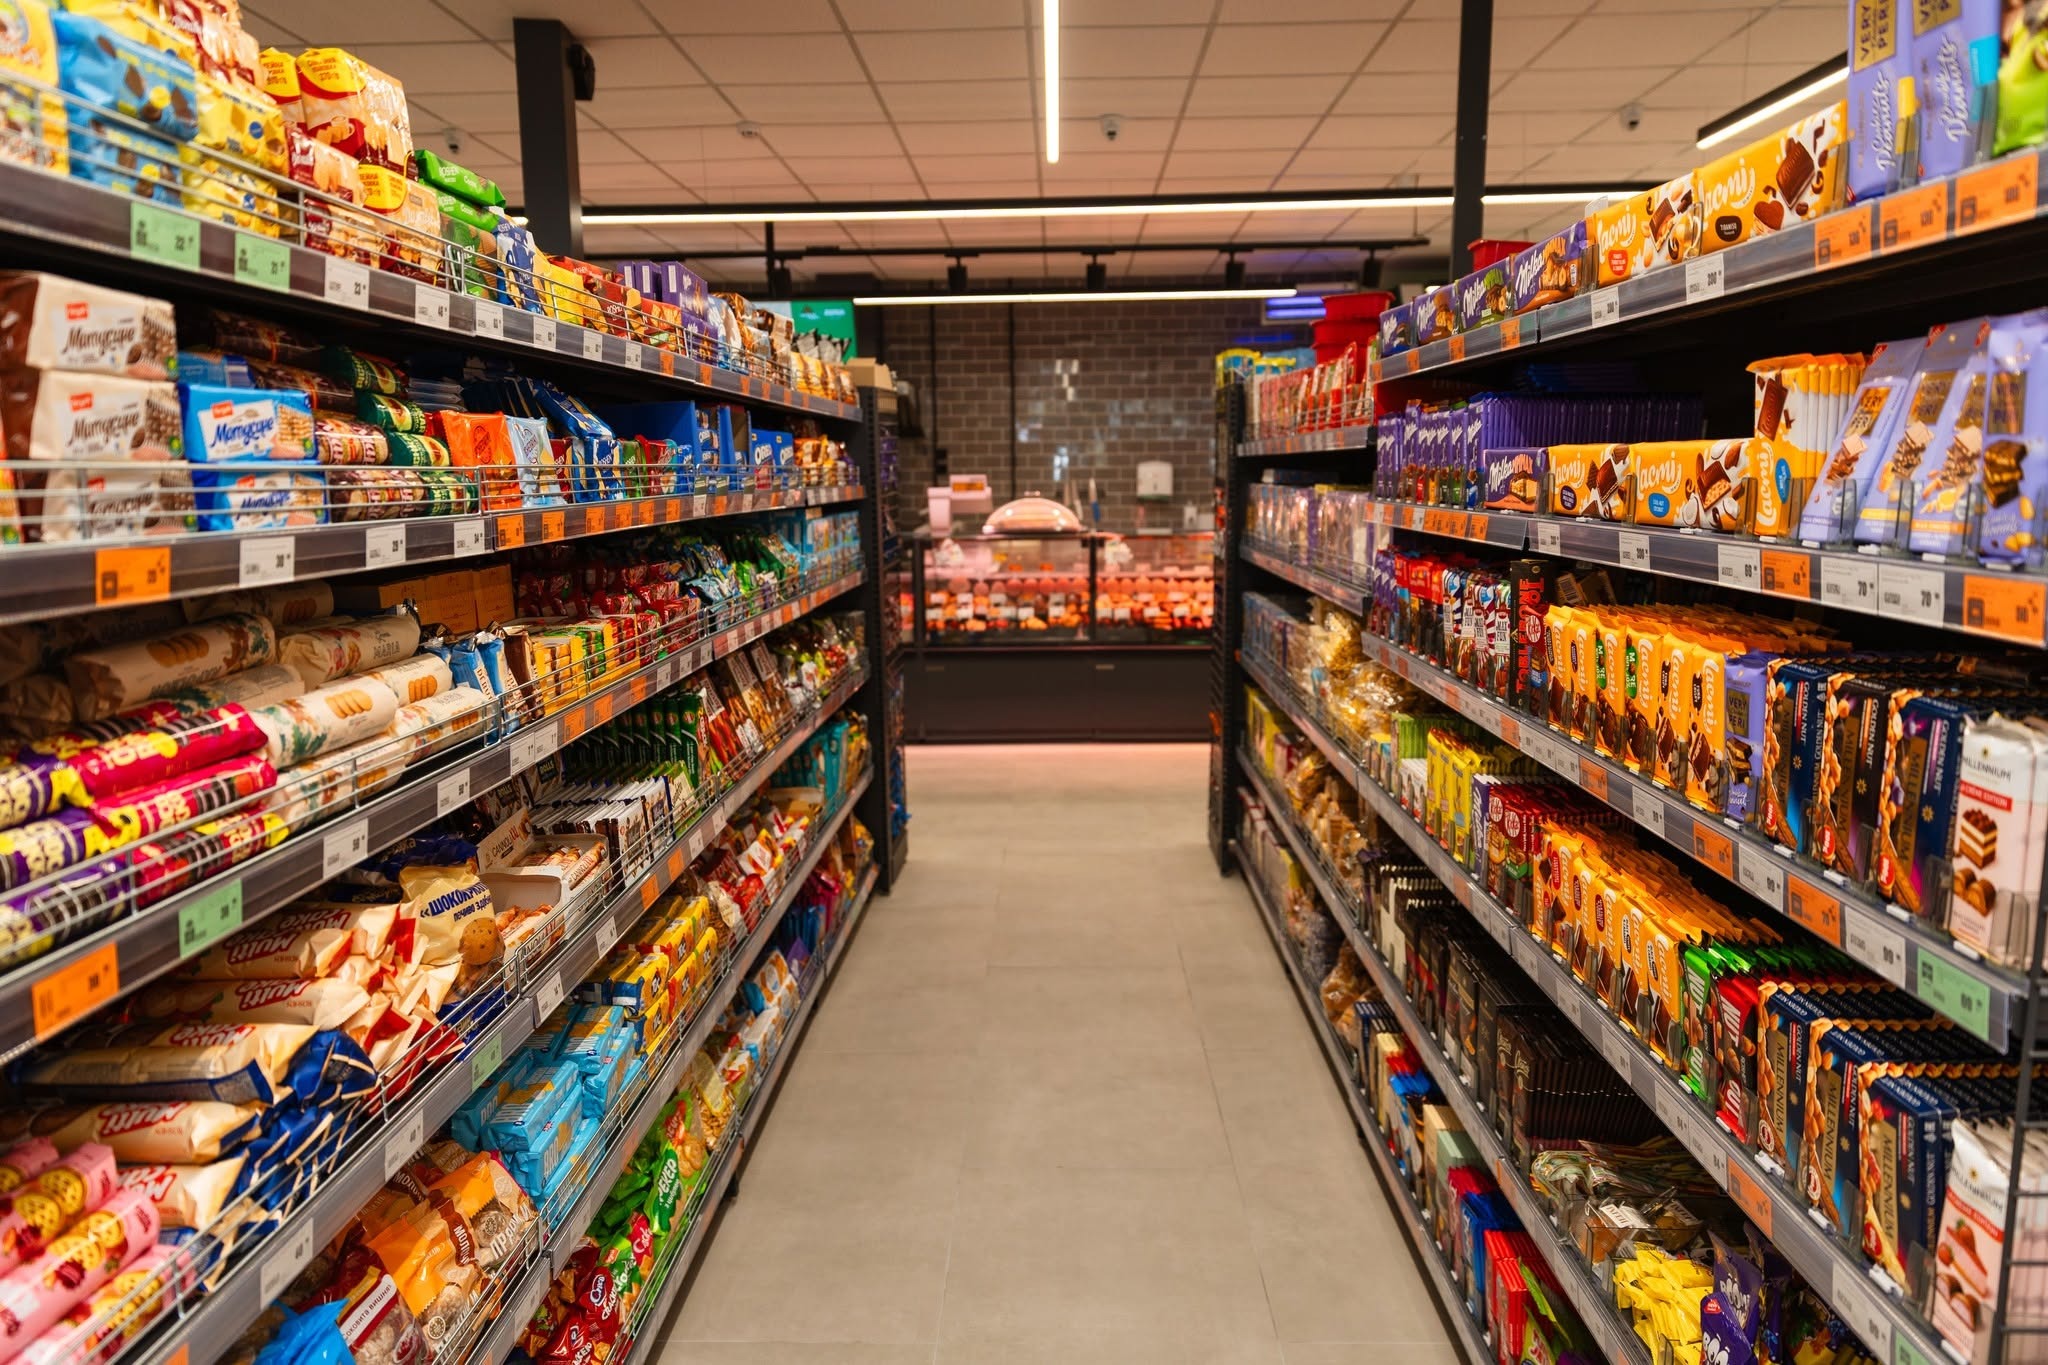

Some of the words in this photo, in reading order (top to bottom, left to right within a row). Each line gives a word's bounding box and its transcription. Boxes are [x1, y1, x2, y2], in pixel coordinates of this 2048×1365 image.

[1515, 249, 1544, 298] Milka
[1417, 298, 1436, 331] Milka
[1463, 281, 1485, 317] Milka
[1467, 418, 1483, 444] Milka
[1489, 456, 1513, 492] Milka
[1801, 681, 1810, 722] GOLDEN
[1870, 698, 1879, 738] GOLDEN
[1937, 719, 1949, 767] GOLDEN
[1934, 769, 1942, 794] NUT
[1899, 751, 1923, 864] MILLENNIUM
[242, 981, 311, 1010] Multi
[1687, 967, 1705, 1014] NUT
[1720, 994, 1741, 1048] NUT
[1774, 1042, 1786, 1132] MILLENNIUM
[1824, 1087, 1837, 1182] MILLENNIUM
[1881, 1135, 1893, 1238] MILLENNIUM
